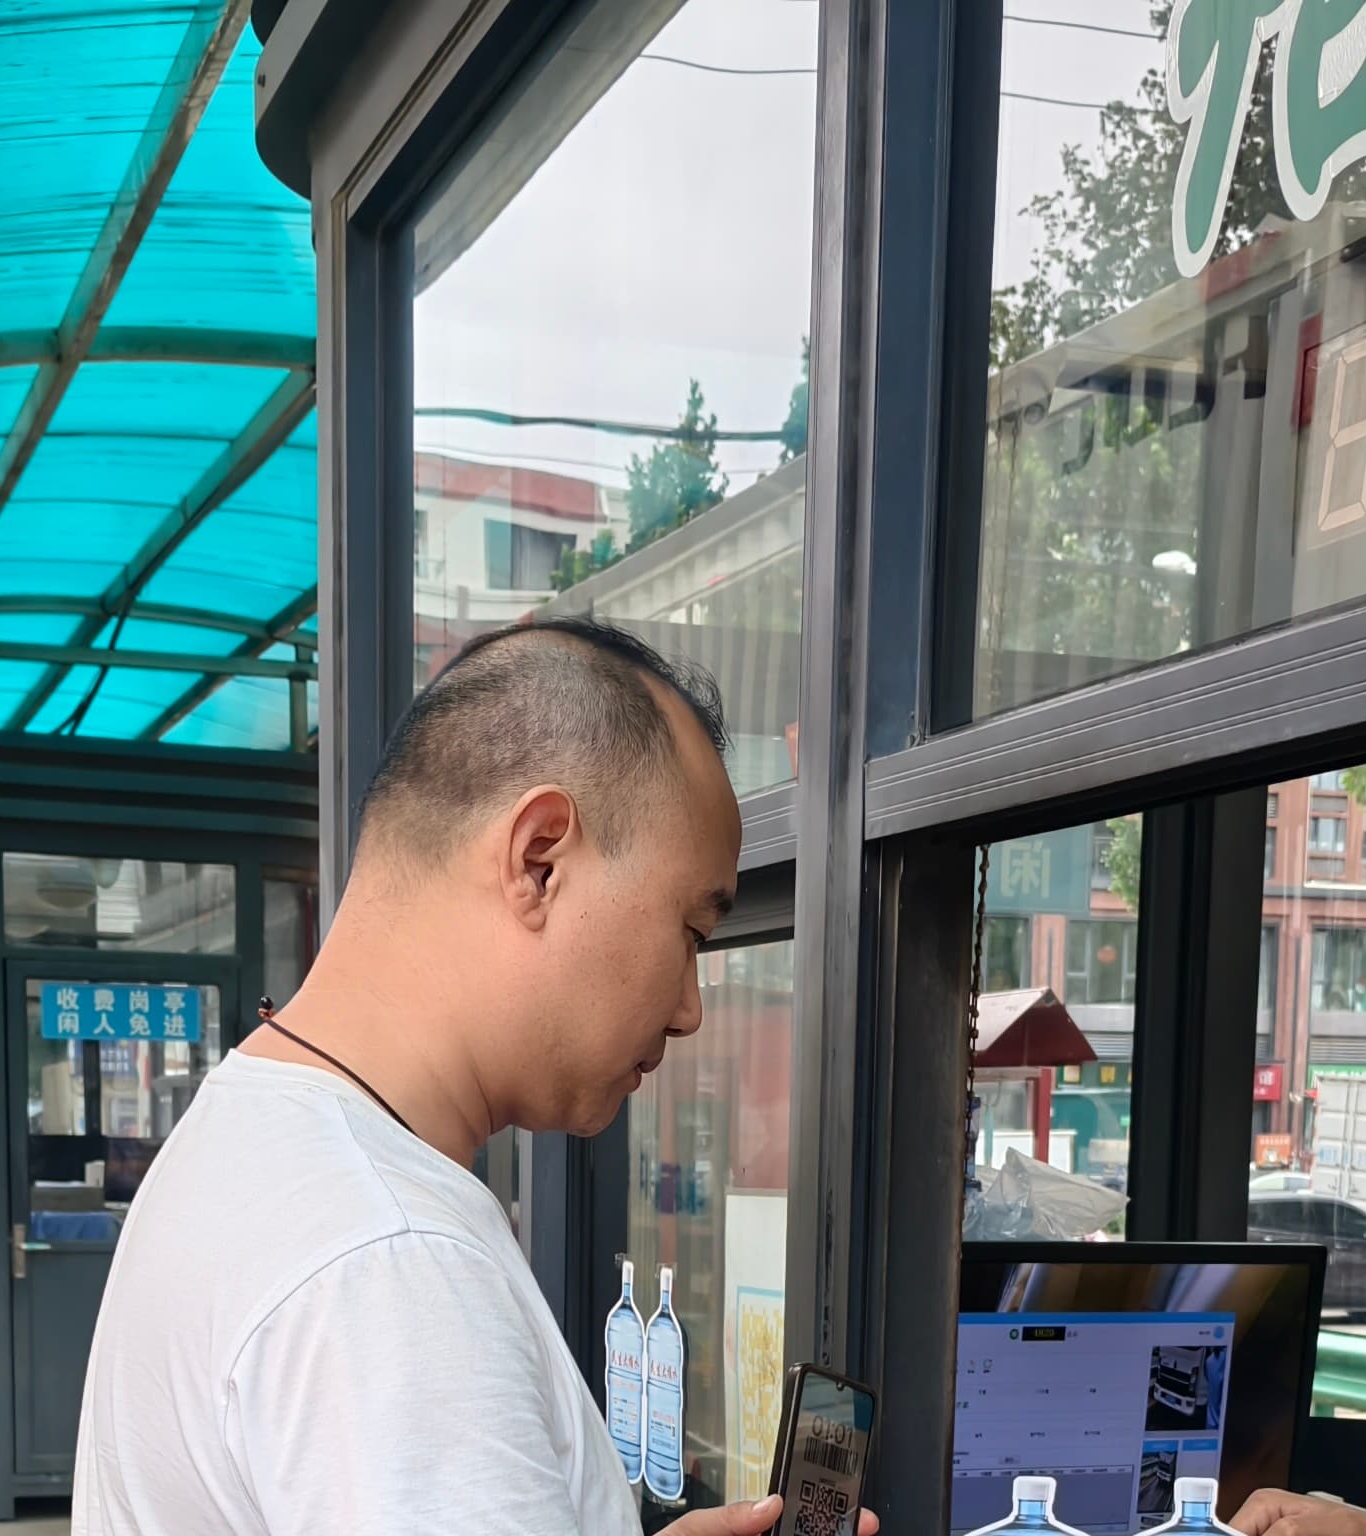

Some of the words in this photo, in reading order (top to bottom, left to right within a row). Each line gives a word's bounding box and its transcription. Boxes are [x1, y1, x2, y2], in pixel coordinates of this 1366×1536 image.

[56, 987, 186, 1014] 收费岗亭
[57, 1012, 186, 1037] 闲人免进
